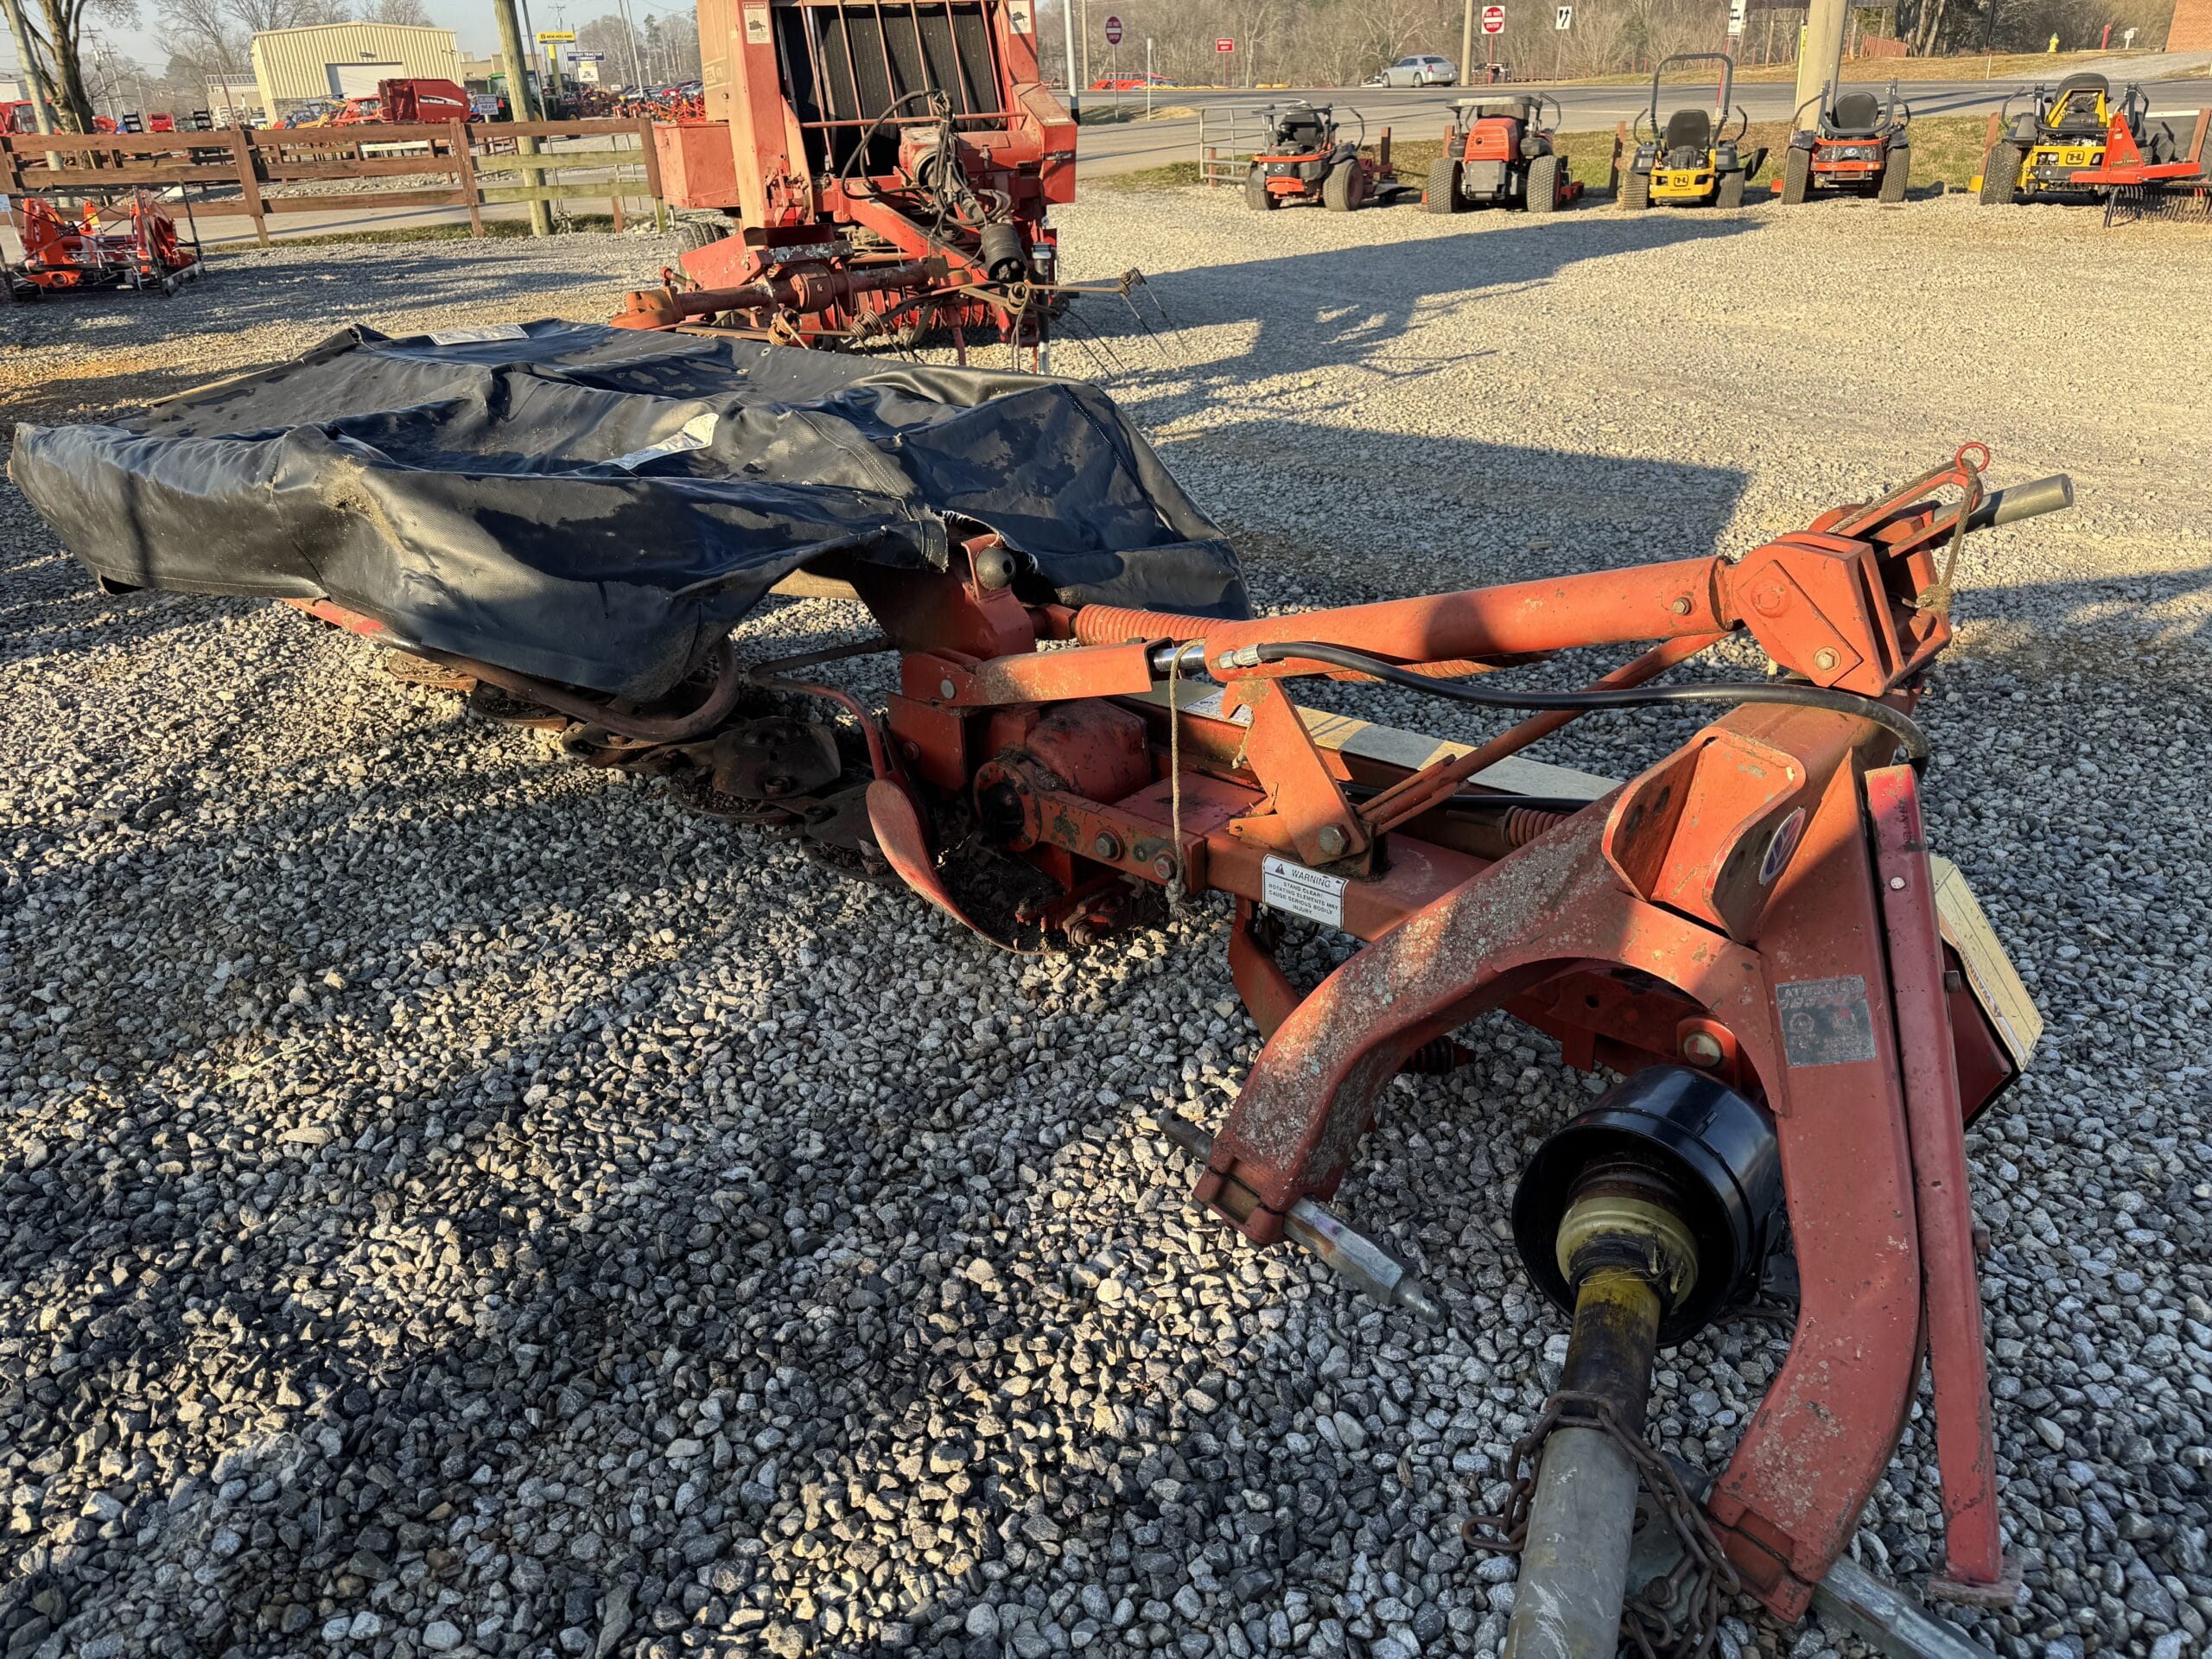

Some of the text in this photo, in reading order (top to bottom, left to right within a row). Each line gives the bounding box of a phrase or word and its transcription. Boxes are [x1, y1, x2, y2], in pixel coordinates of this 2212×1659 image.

[1283, 881, 1301, 892] STAND
[1292, 869, 1331, 888] WARNING
[1268, 883, 1338, 911] ROTATING ELEMENTS MAY
[1268, 890, 1332, 915] CAUSE SERIOUS BODILY
[1293, 904, 1313, 914] INJURY
